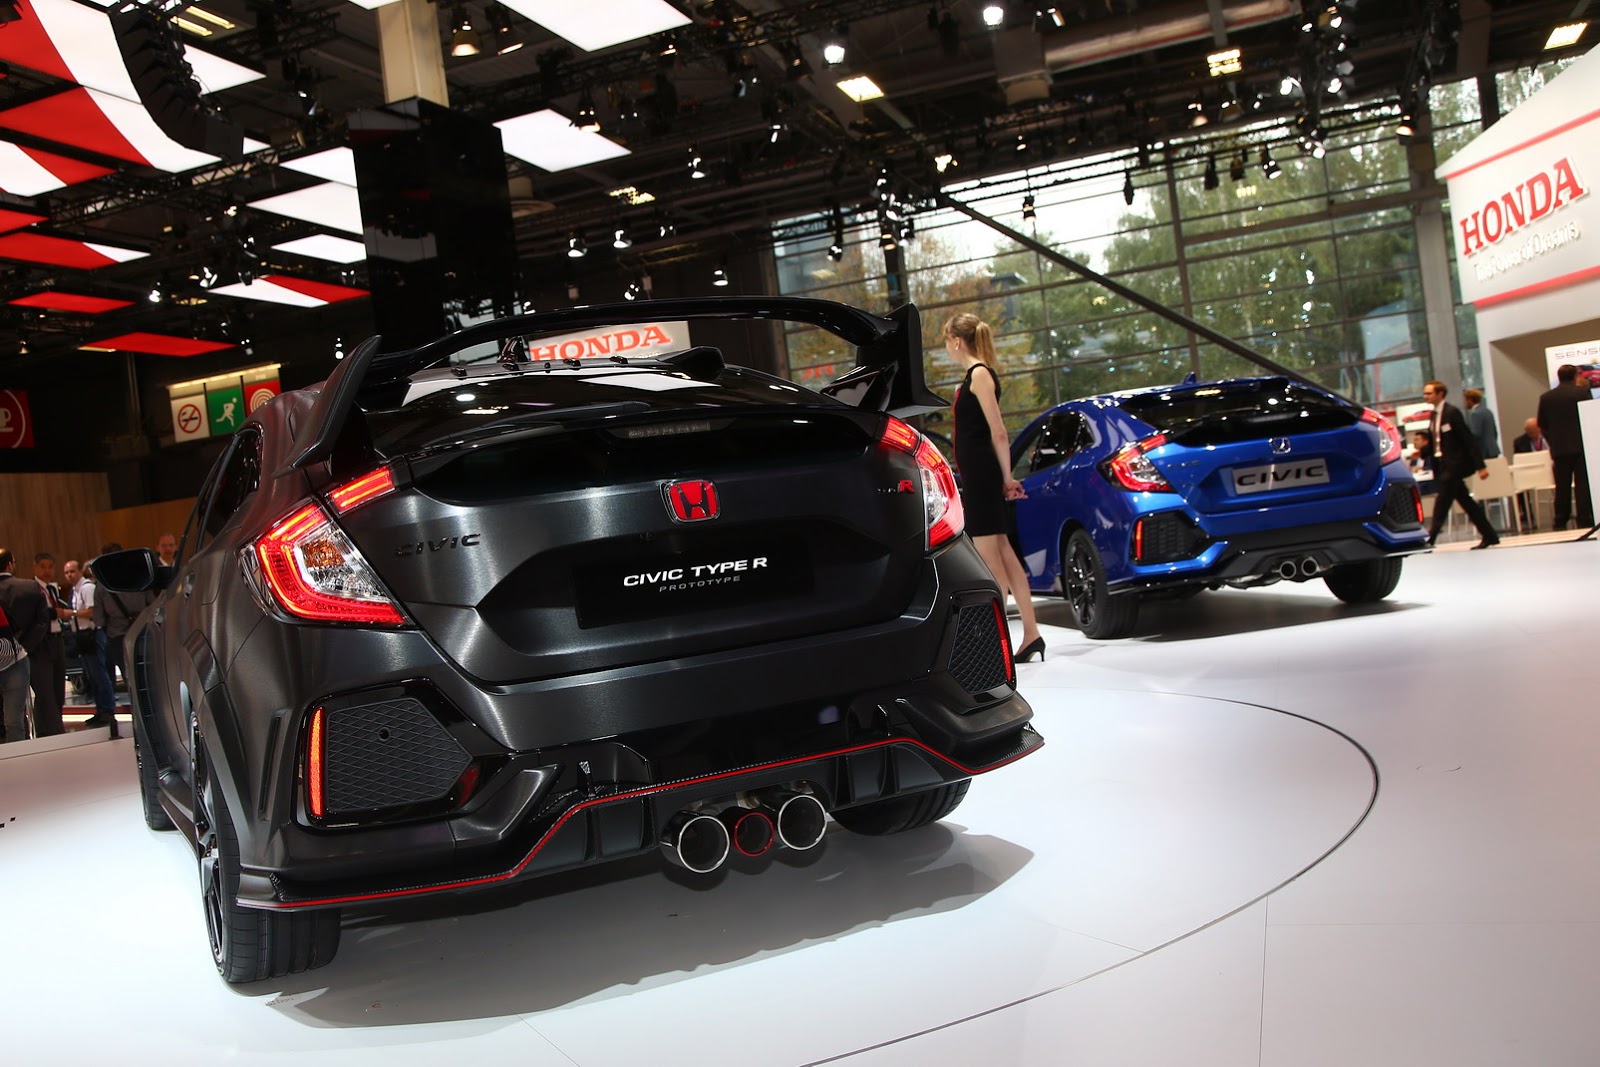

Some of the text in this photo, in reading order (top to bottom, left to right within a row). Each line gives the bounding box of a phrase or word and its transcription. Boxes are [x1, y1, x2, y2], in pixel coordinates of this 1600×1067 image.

[1460, 157, 1584, 256] HONDA
[530, 325, 671, 361] HONDA
[1236, 465, 1324, 486] CIVIC
[394, 533, 481, 556] CIVIC
[623, 556, 768, 587] CIVIC TYPE R
[659, 575, 741, 592] PROTOTYPE
